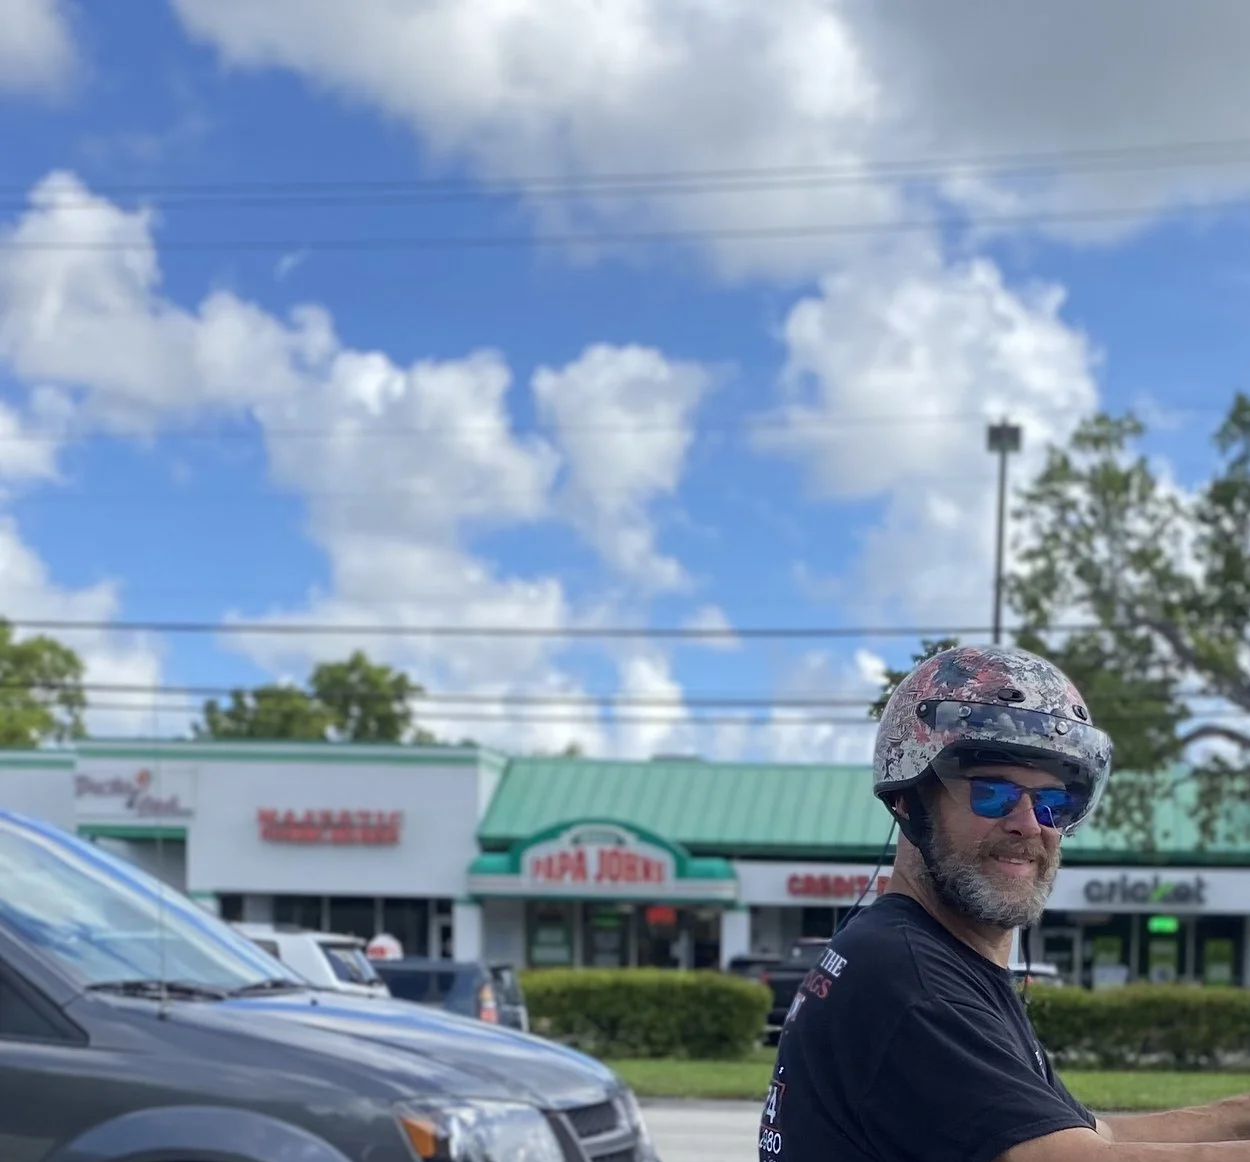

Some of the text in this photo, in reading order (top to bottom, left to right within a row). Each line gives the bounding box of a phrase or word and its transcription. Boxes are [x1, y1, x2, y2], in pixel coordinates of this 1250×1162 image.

[532, 848, 587, 883] PAPA
[787, 873, 870, 897] CREDIT
[1083, 872, 1207, 904] cricket
[820, 947, 848, 978] THE
